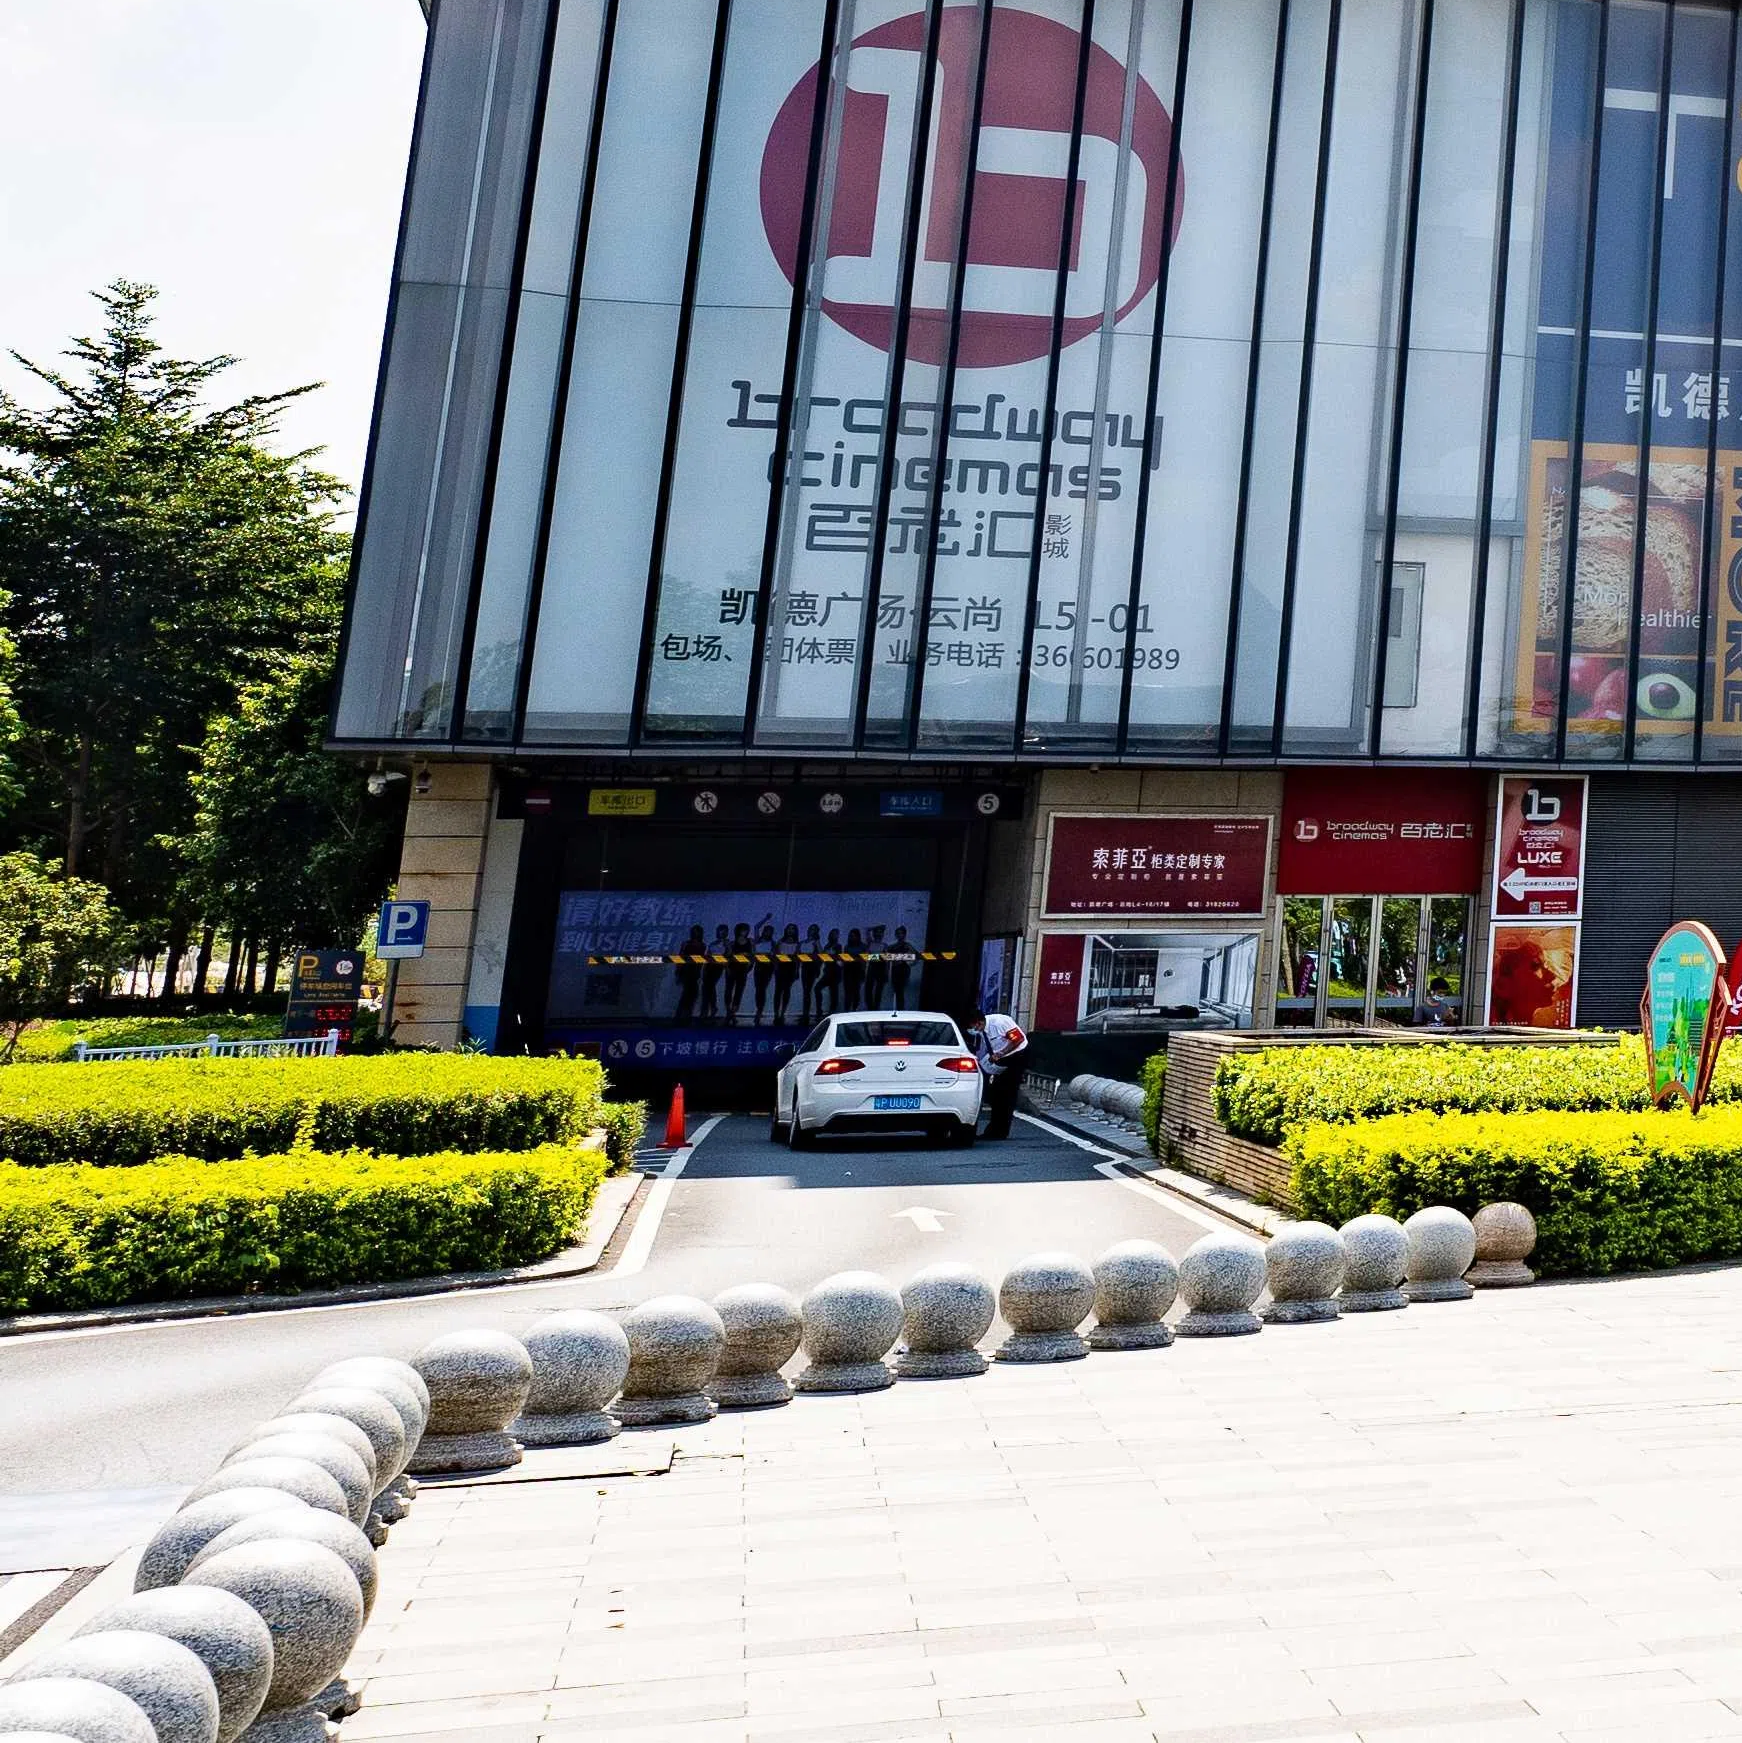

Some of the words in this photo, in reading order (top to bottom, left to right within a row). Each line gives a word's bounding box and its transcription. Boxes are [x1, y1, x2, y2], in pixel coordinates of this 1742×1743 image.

[727, 380, 1165, 471] broadway
[767, 441, 1122, 501] cinemas
[1043, 514, 1072, 560] 影城
[1616, 609, 1713, 630] ealthie
[1326, 820, 1394, 834] broadway
[1332, 831, 1388, 841] cinemas
[1517, 851, 1563, 864] LUXE
[386, 905, 418, 944] P
